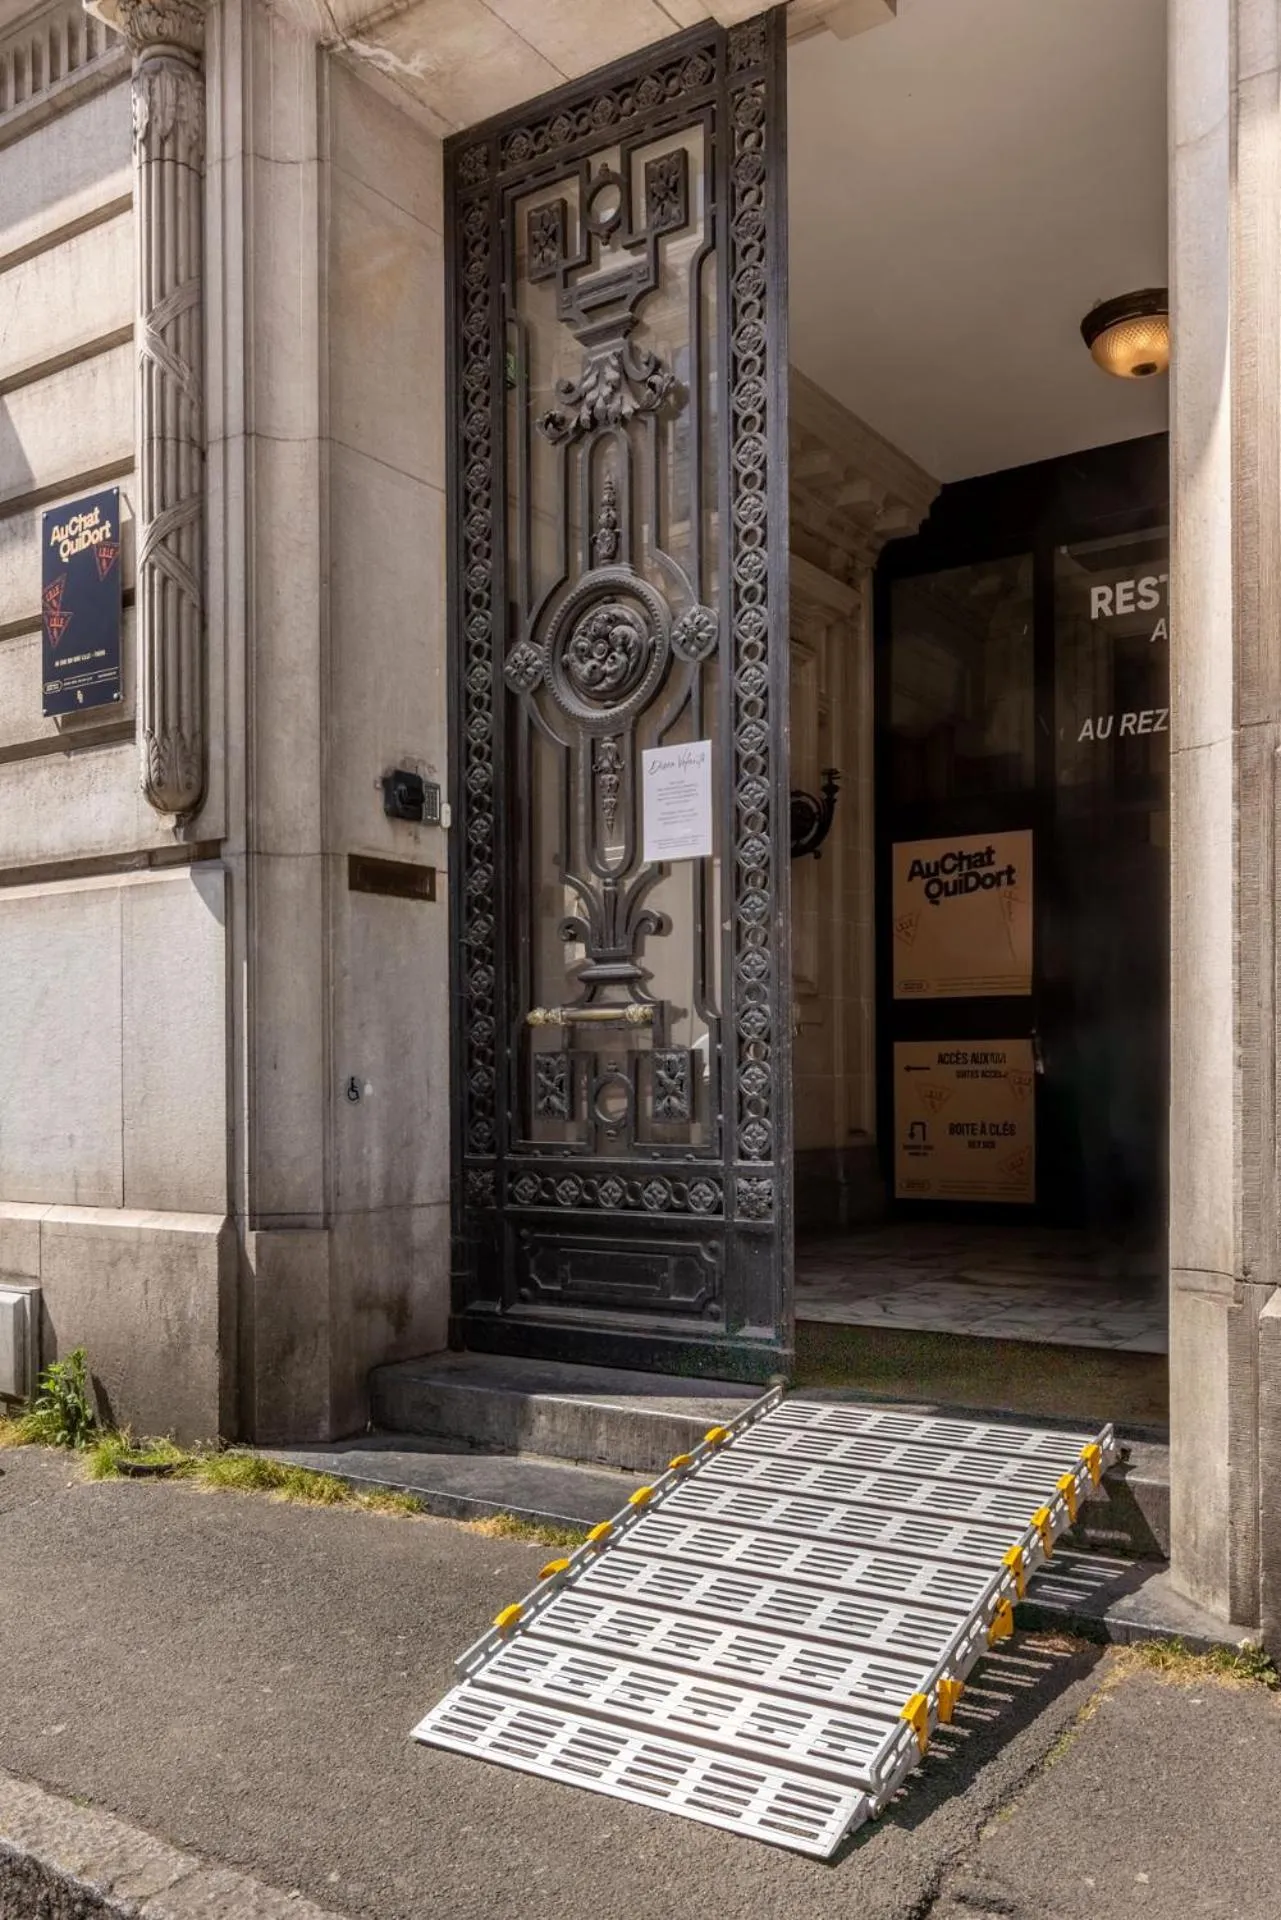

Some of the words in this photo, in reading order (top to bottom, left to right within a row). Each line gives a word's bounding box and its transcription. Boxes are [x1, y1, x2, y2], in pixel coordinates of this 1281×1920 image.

[49, 506, 101, 546] AuChat
[59, 520, 112, 562] QuiDort
[1150, 617, 1168, 642] A
[1078, 715, 1114, 742] AU
[1120, 708, 1169, 737] REZ
[907, 844, 996, 882] AuChat
[924, 863, 1016, 906] QuiDort
[937, 1048, 968, 1065] ACCÈS
